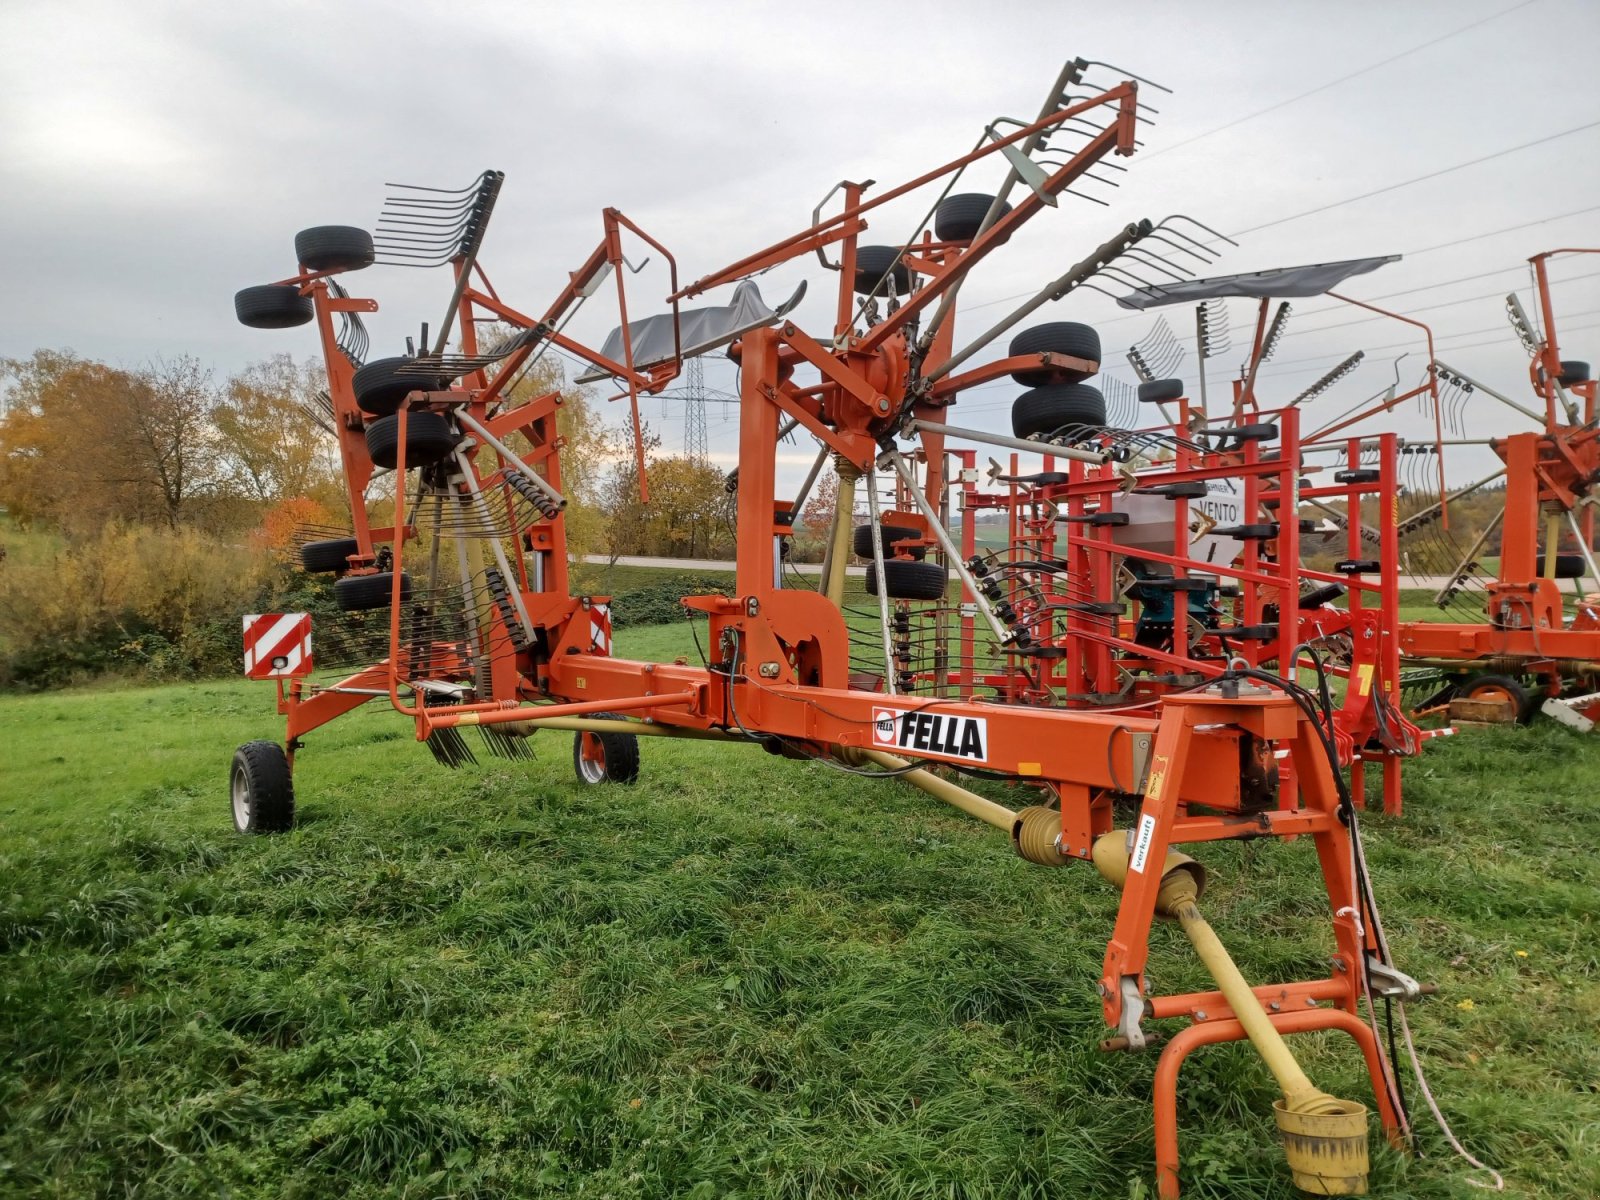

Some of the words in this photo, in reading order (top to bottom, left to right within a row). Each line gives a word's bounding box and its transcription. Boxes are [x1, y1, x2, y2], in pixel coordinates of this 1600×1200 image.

[1206, 483, 1229, 494] EHNER
[1200, 500, 1237, 522] VENTO
[876, 720, 894, 732] FELLA
[899, 711, 984, 760] FELLA
[1136, 819, 1151, 867] verkauft
